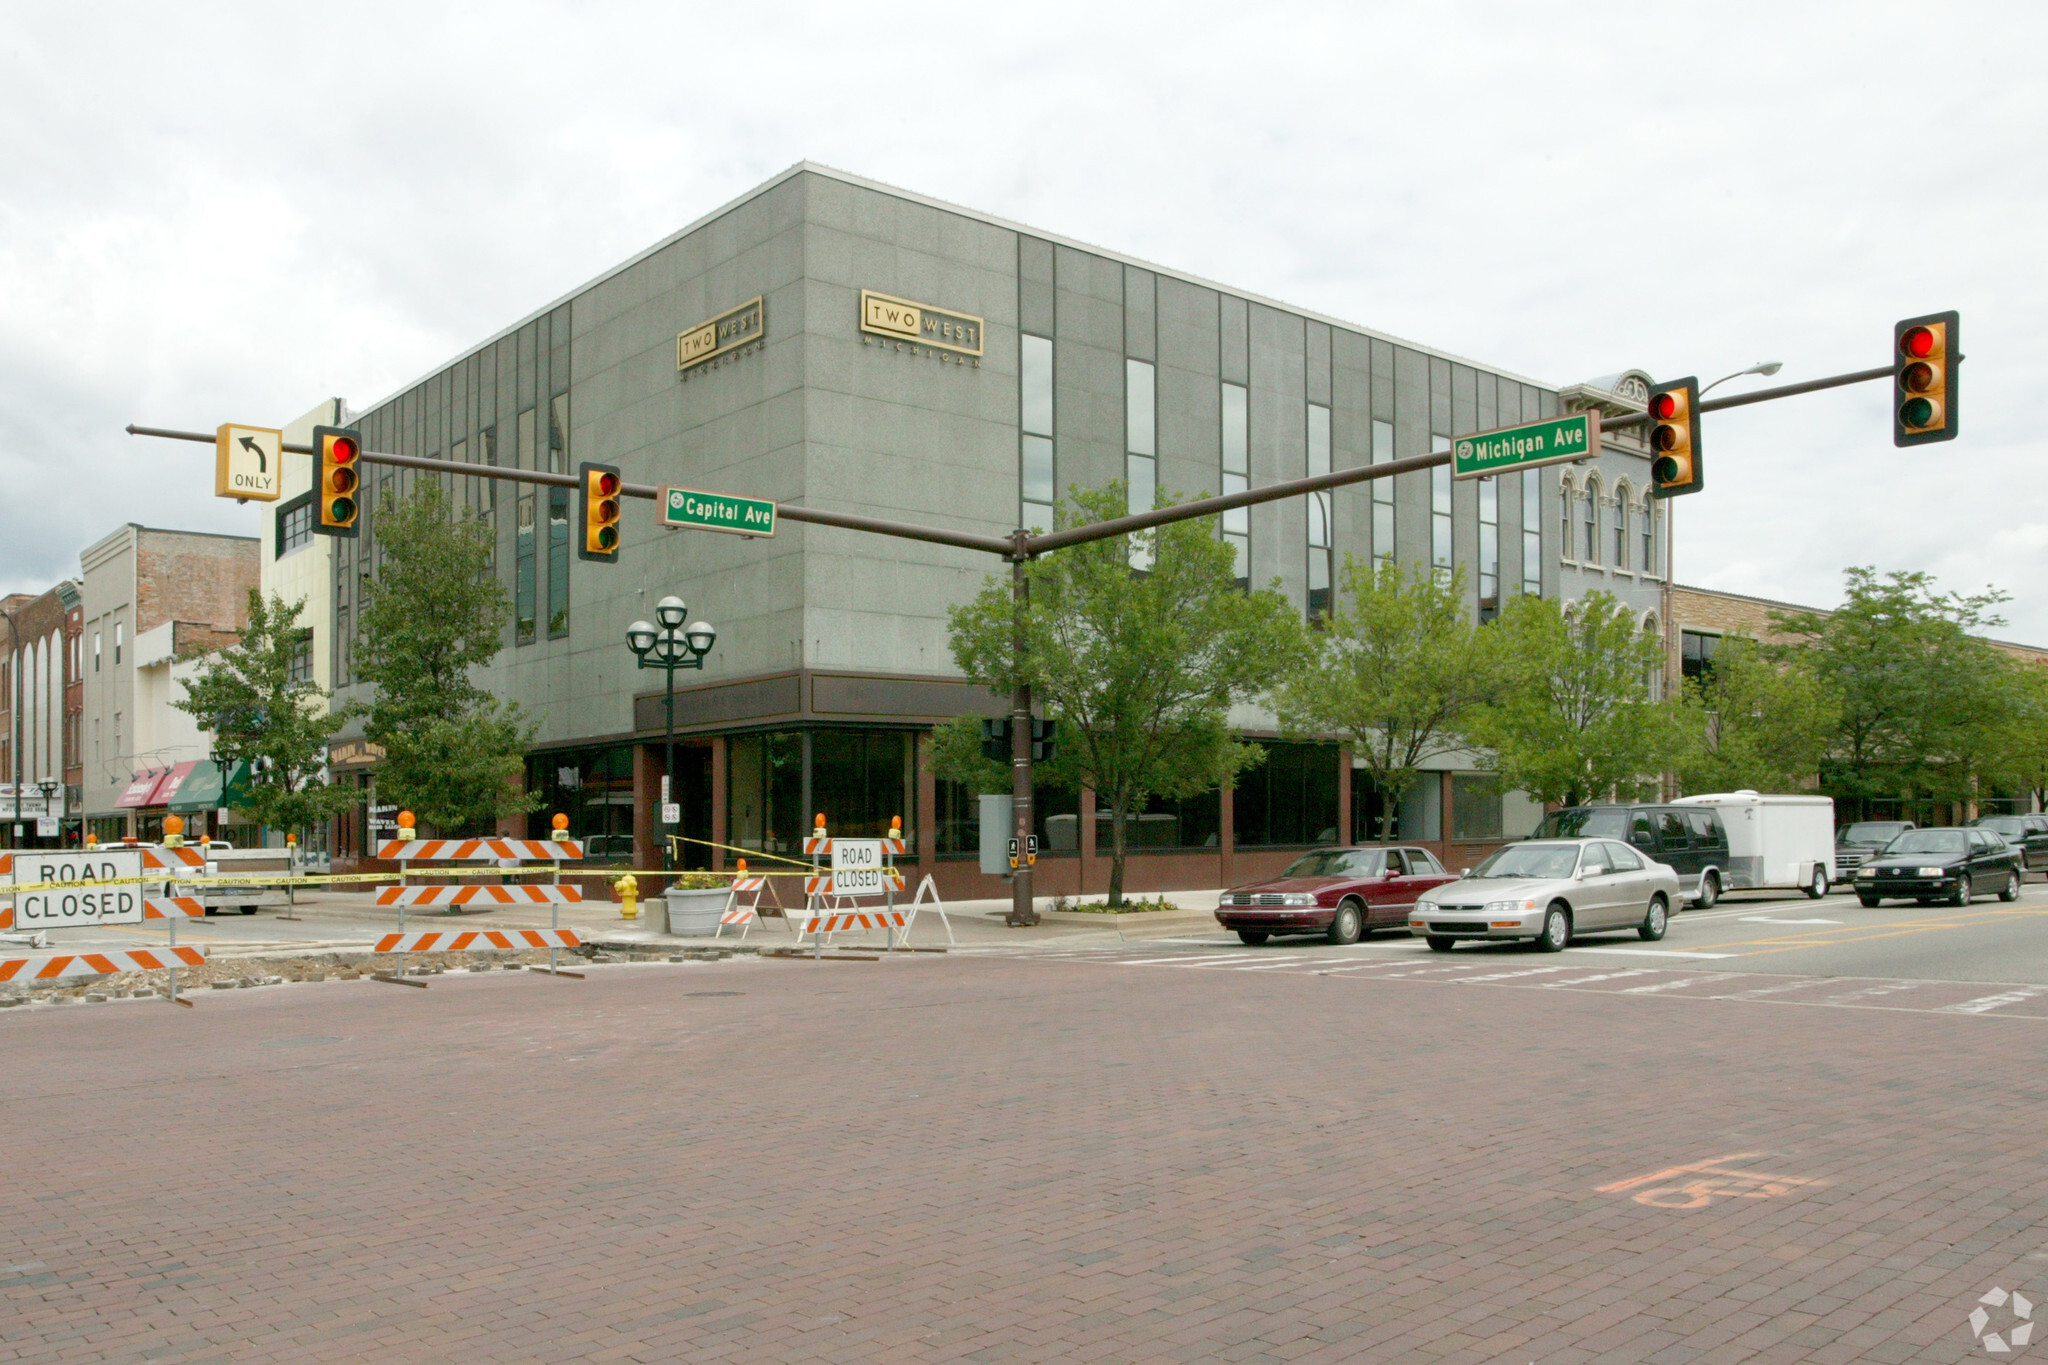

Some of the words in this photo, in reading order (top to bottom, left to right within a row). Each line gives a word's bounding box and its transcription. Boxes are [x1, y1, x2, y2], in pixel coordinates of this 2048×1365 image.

[684, 332, 712, 355] TWO
[718, 311, 757, 338] WEST
[874, 306, 915, 327] TWO
[925, 317, 975, 341] WEST
[864, 336, 981, 368] MICHIGAN
[1476, 434, 1544, 461] Michigan
[1554, 427, 1583, 447] Ave
[235, 473, 272, 489] ONLY
[686, 498, 738, 521] Capital
[745, 505, 770, 524] Ave
[842, 847, 872, 864] ROAD
[40, 862, 117, 884] ROAD
[275, 877, 308, 885] CAUTION
[330, 875, 362, 884] CAUTION
[383, 872, 406, 881] CAUTIO
[471, 868, 501, 876] CAUTION
[836, 870, 878, 888] CLOSED
[0, 885, 21, 893] TION
[49, 880, 86, 889] CAUTION
[113, 876, 149, 886] CAUTION
[25, 892, 133, 919] CLOSED
